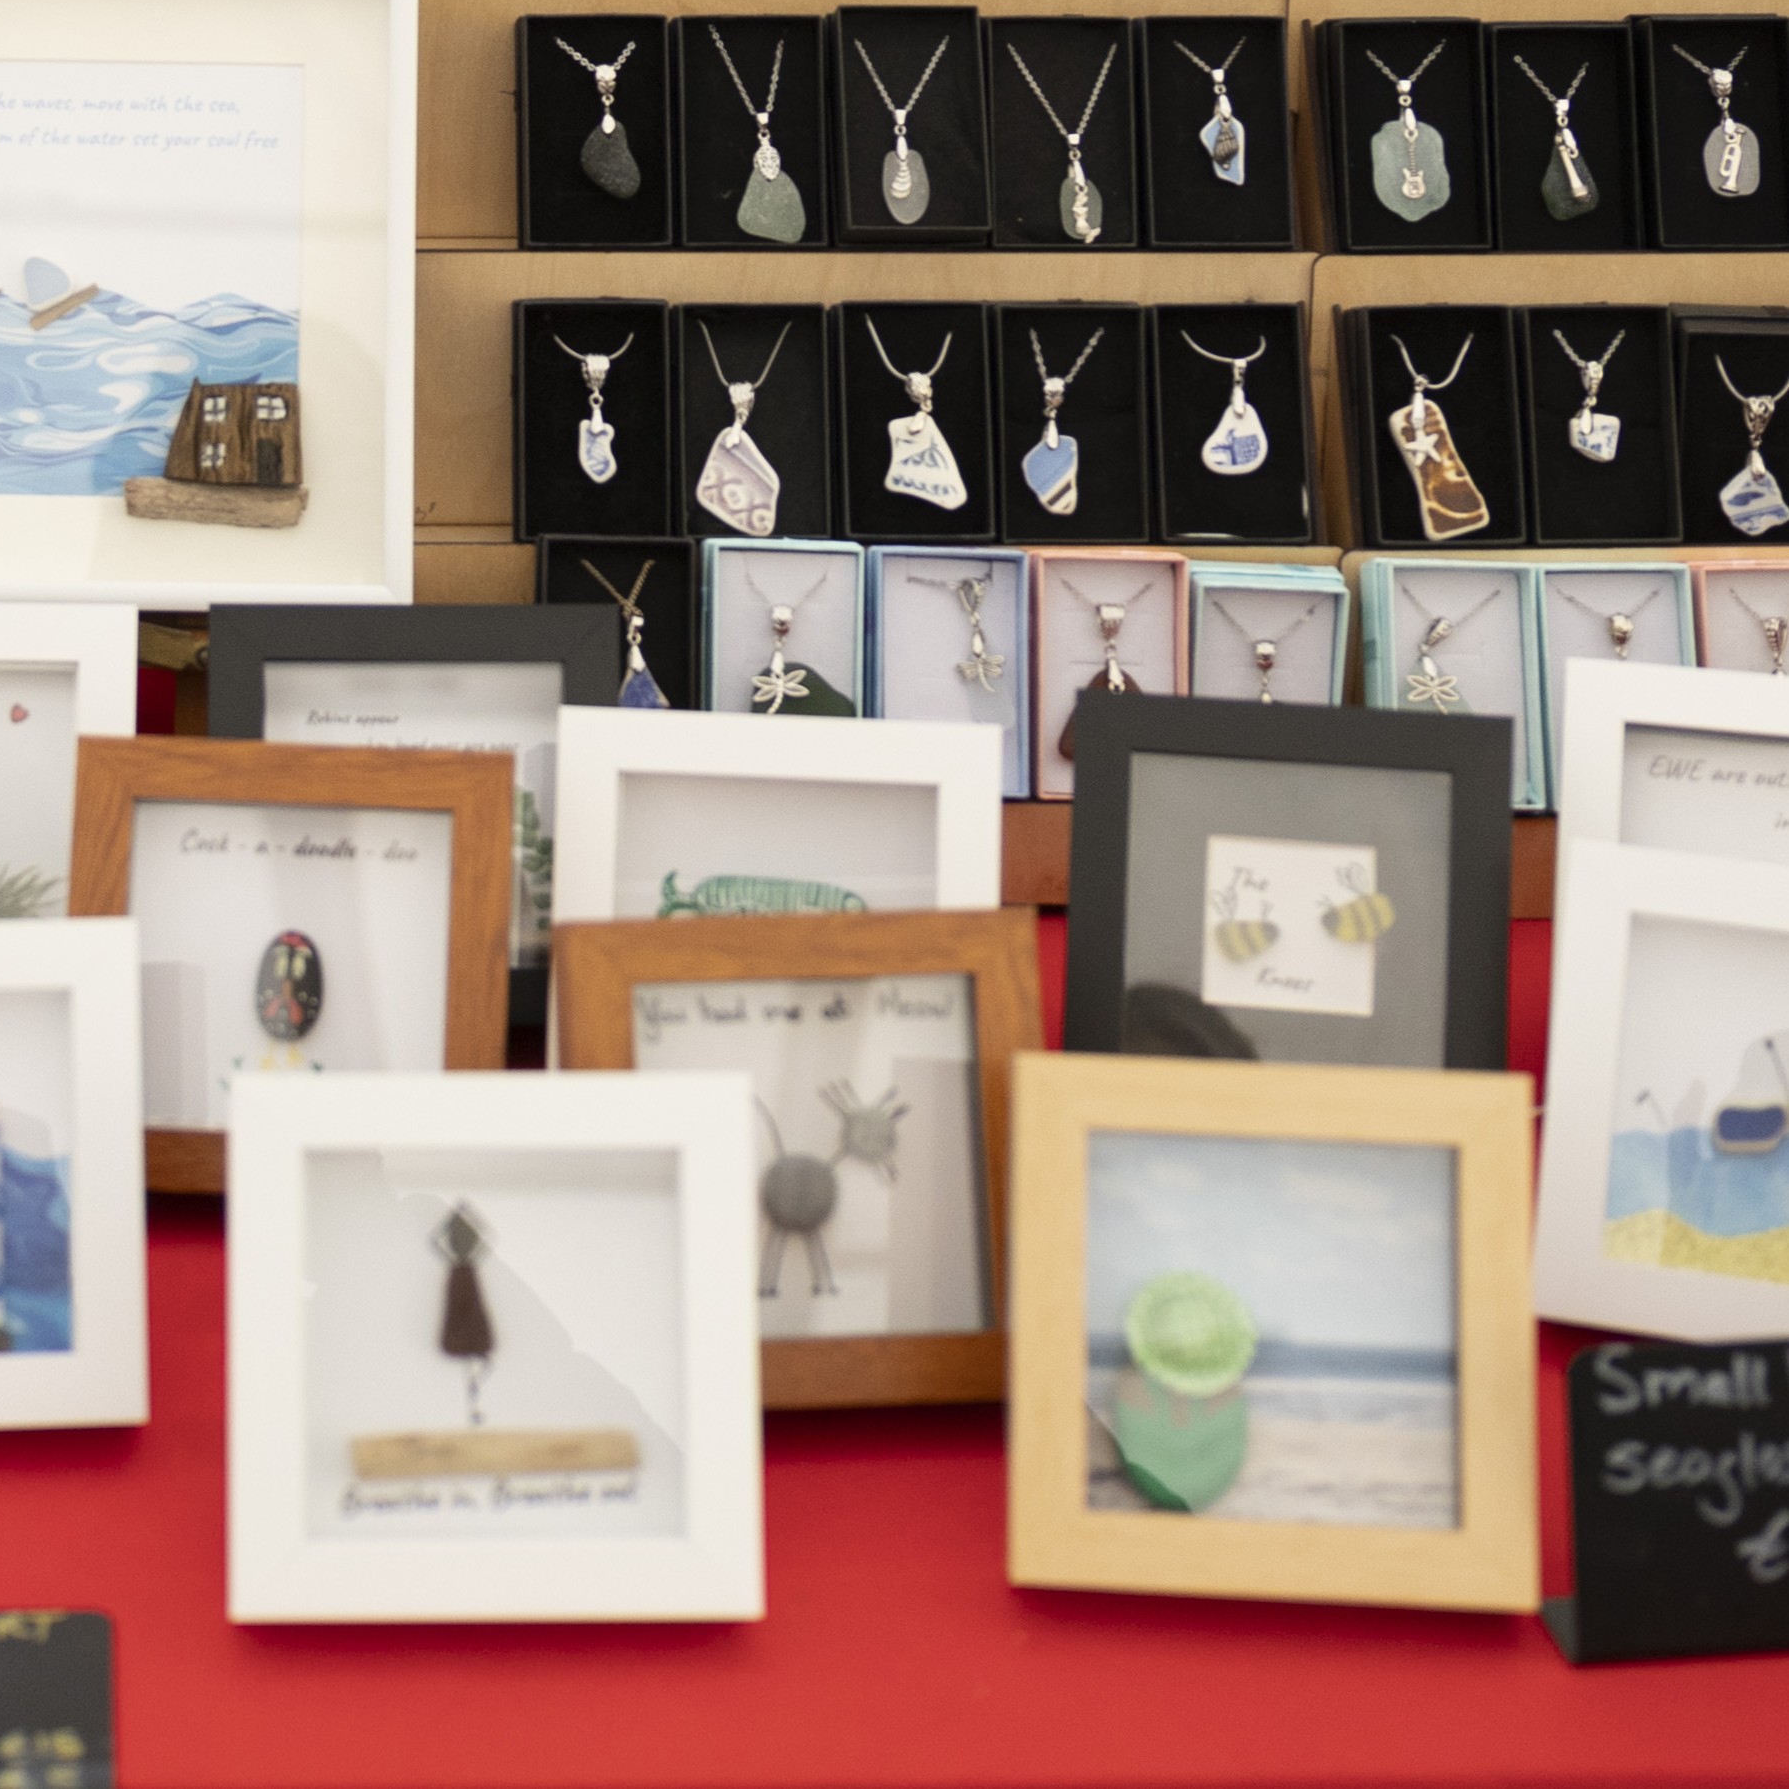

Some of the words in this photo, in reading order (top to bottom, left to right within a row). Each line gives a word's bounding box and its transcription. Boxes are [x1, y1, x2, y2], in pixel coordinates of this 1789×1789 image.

[130, 95, 167, 111] with
[174, 95, 203, 111] the
[19, 127, 39, 145] of
[42, 127, 70, 144] the
[77, 132, 125, 145] water
[162, 136, 201, 151] your
[245, 131, 279, 149] free
[1594, 1341, 1771, 1415] Small
